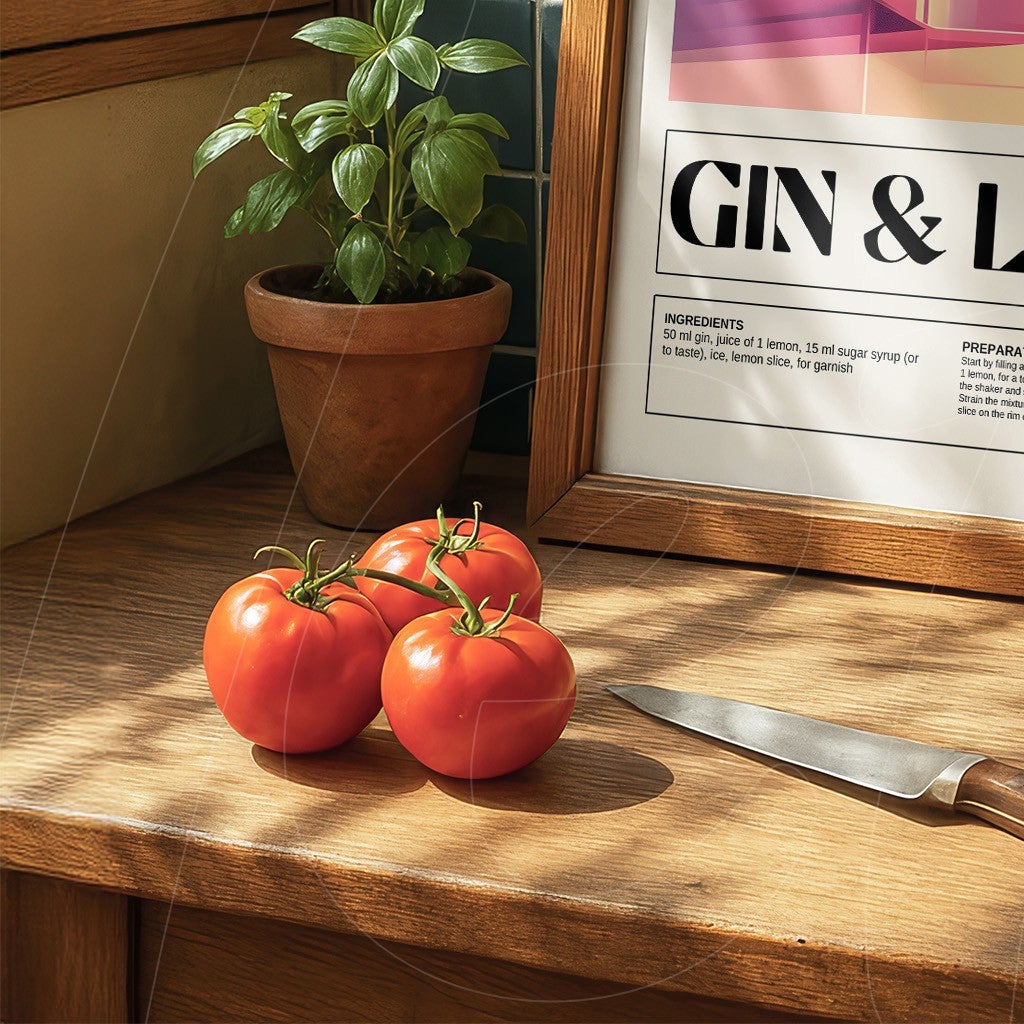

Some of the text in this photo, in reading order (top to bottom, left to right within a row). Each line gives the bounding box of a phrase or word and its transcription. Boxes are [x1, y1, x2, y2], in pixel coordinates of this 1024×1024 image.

[670, 160, 836, 255] GIN
[863, 175, 946, 265] &
[664, 313, 744, 330] INGREDIENTS
[663, 329, 919, 365] 50 ml gin, juice of 1 lemon, 15 ml sugar syrup (or
[662, 345, 853, 373] to taste), ice, lemon slice, for garnish
[961, 357, 981, 366] Start
[983, 359, 993, 368] by
[995, 360, 1017, 371] filling
[1019, 363, 1024, 371] a
[961, 369, 965, 377] 1
[968, 369, 996, 381] lemon,
[998, 372, 1009, 381] for
[960, 382, 972, 390] the
[975, 383, 1003, 394] shaker
[1005, 386, 1021, 395] and
[959, 394, 983, 404] Strain
[985, 396, 998, 405] the
[958, 406, 976, 416] slice
[979, 409, 989, 417] on
[992, 409, 1004, 419] the
[1007, 411, 1020, 420] rim
